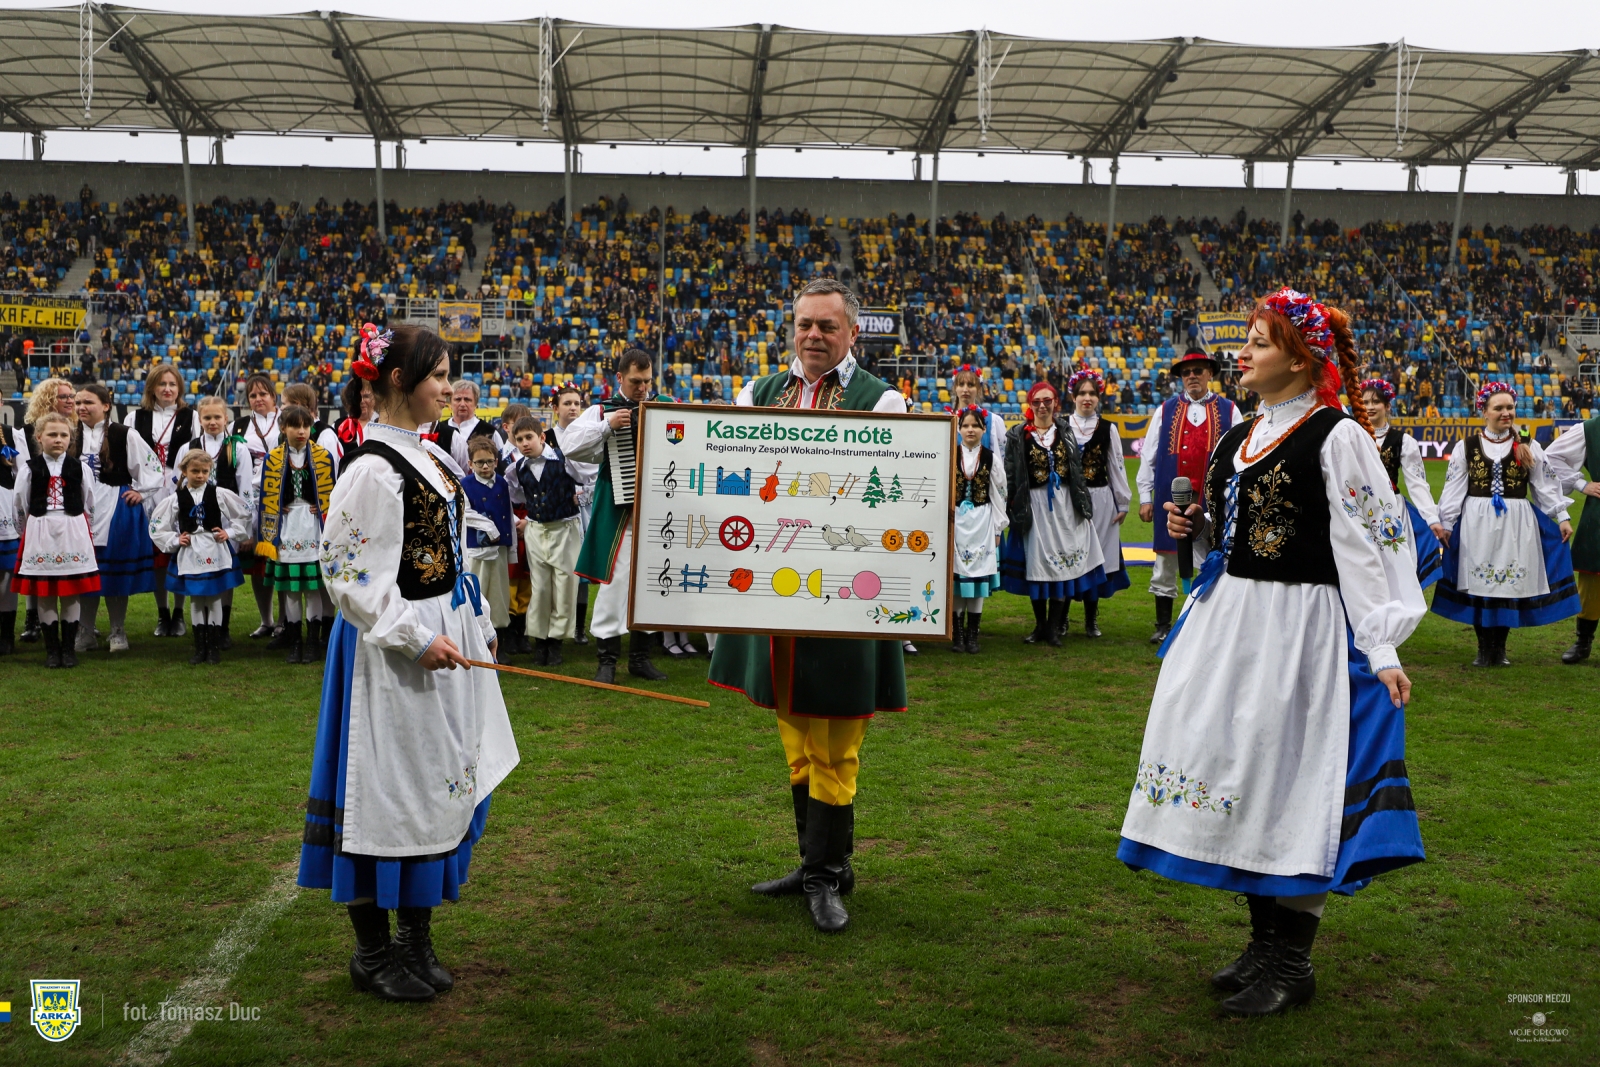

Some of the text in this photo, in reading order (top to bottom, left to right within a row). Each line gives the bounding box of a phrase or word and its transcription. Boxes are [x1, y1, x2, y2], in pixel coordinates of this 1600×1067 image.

[54, 310, 79, 326] HEL
[706, 420, 893, 445] Kaszëbsczé nótë
[706, 442, 757, 455] Regionalny
[758, 444, 789, 455] Zespół
[790, 446, 900, 459] Wokalno-Instrumentalny
[890, 535, 922, 546] 5 5
